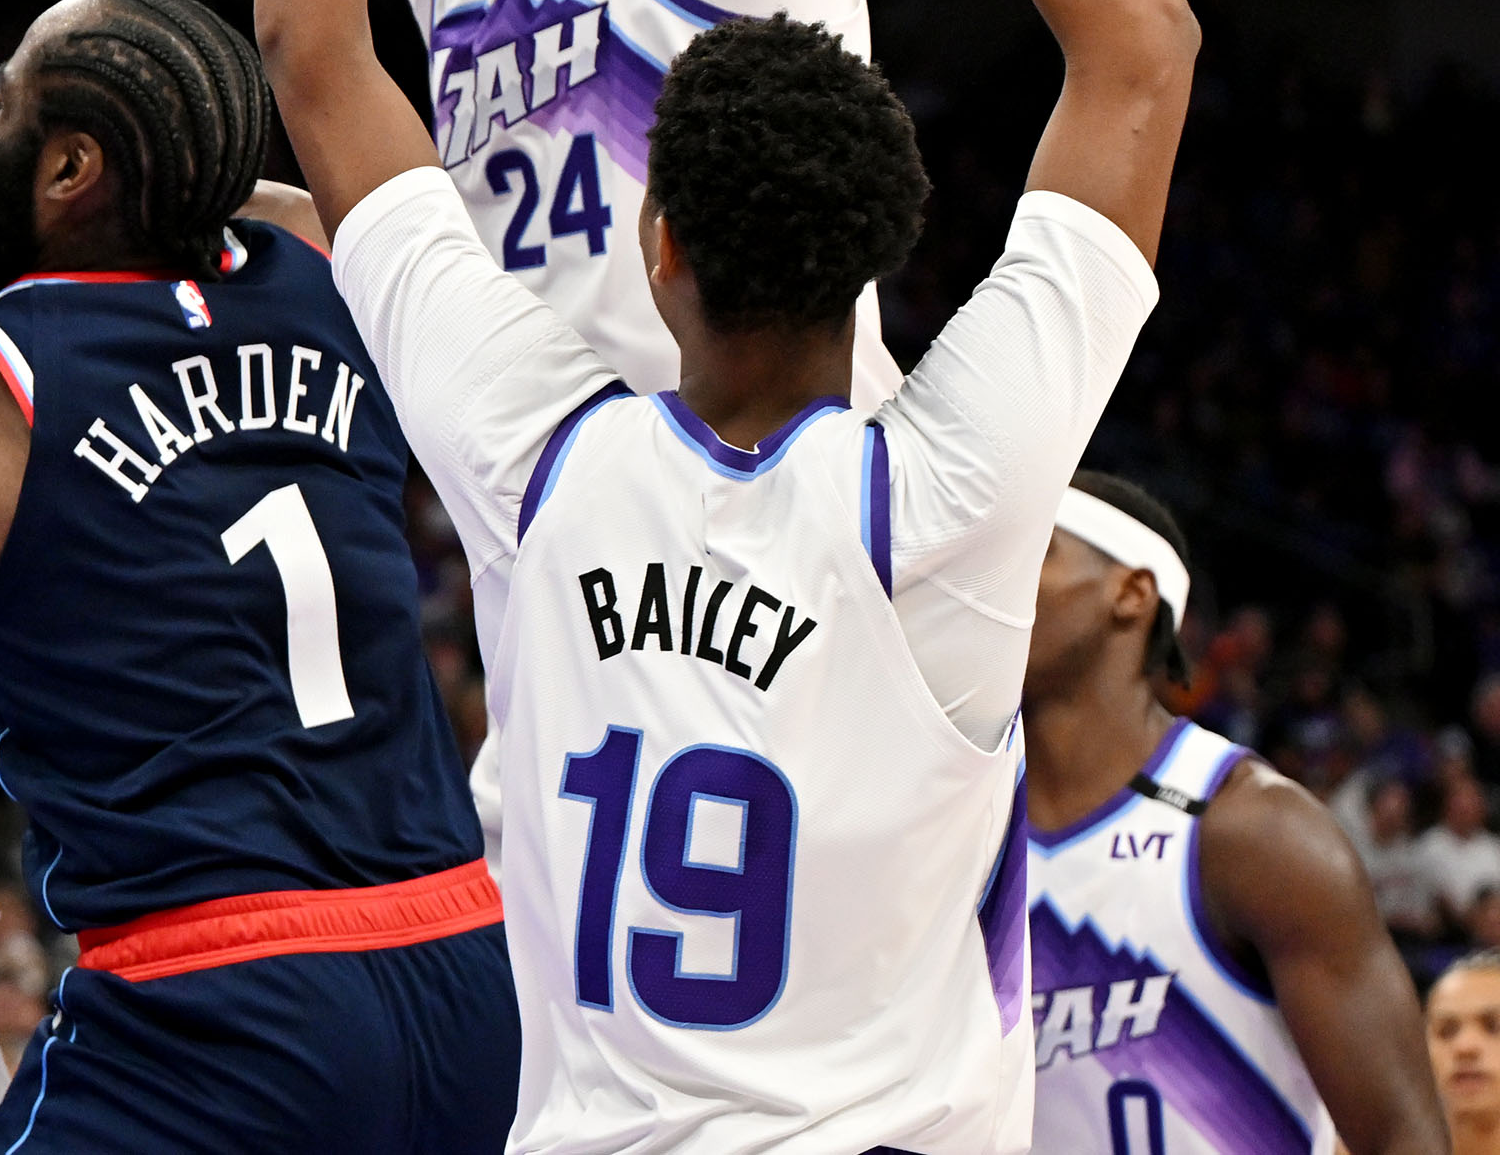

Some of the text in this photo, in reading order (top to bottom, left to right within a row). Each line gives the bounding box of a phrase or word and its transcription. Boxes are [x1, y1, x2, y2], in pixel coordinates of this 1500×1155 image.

[484, 130, 612, 272] 24
[73, 343, 365, 503] HARDEN
[220, 483, 355, 729] 1
[578, 562, 818, 692] BAILEY
[558, 723, 800, 1032] 19
[1110, 832, 1174, 860] LVT
[1032, 972, 1178, 1072] AH
[1106, 1077, 1166, 1155] 0
